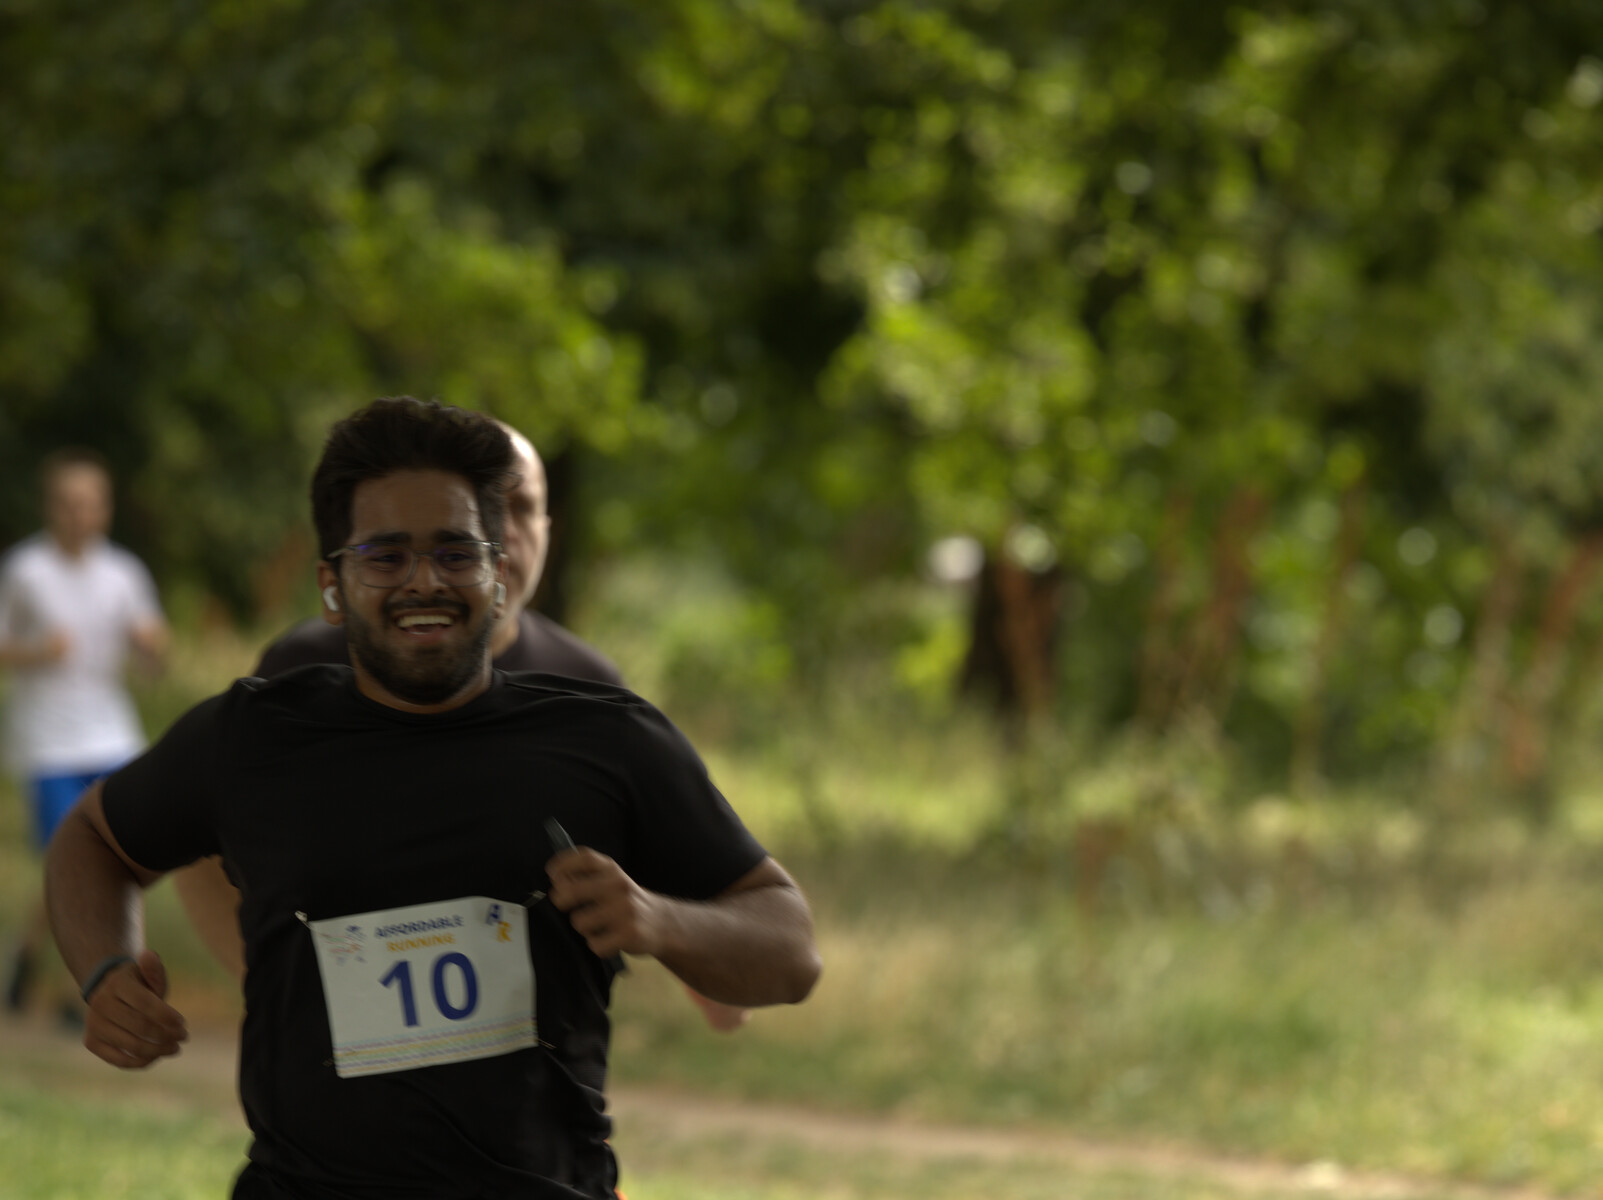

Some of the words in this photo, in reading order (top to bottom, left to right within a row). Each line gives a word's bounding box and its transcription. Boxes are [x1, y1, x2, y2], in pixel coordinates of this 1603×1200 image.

[375, 915, 464, 938] AFFORDABLE
[386, 932, 456, 952] RUNNING
[379, 952, 480, 1027] 10
